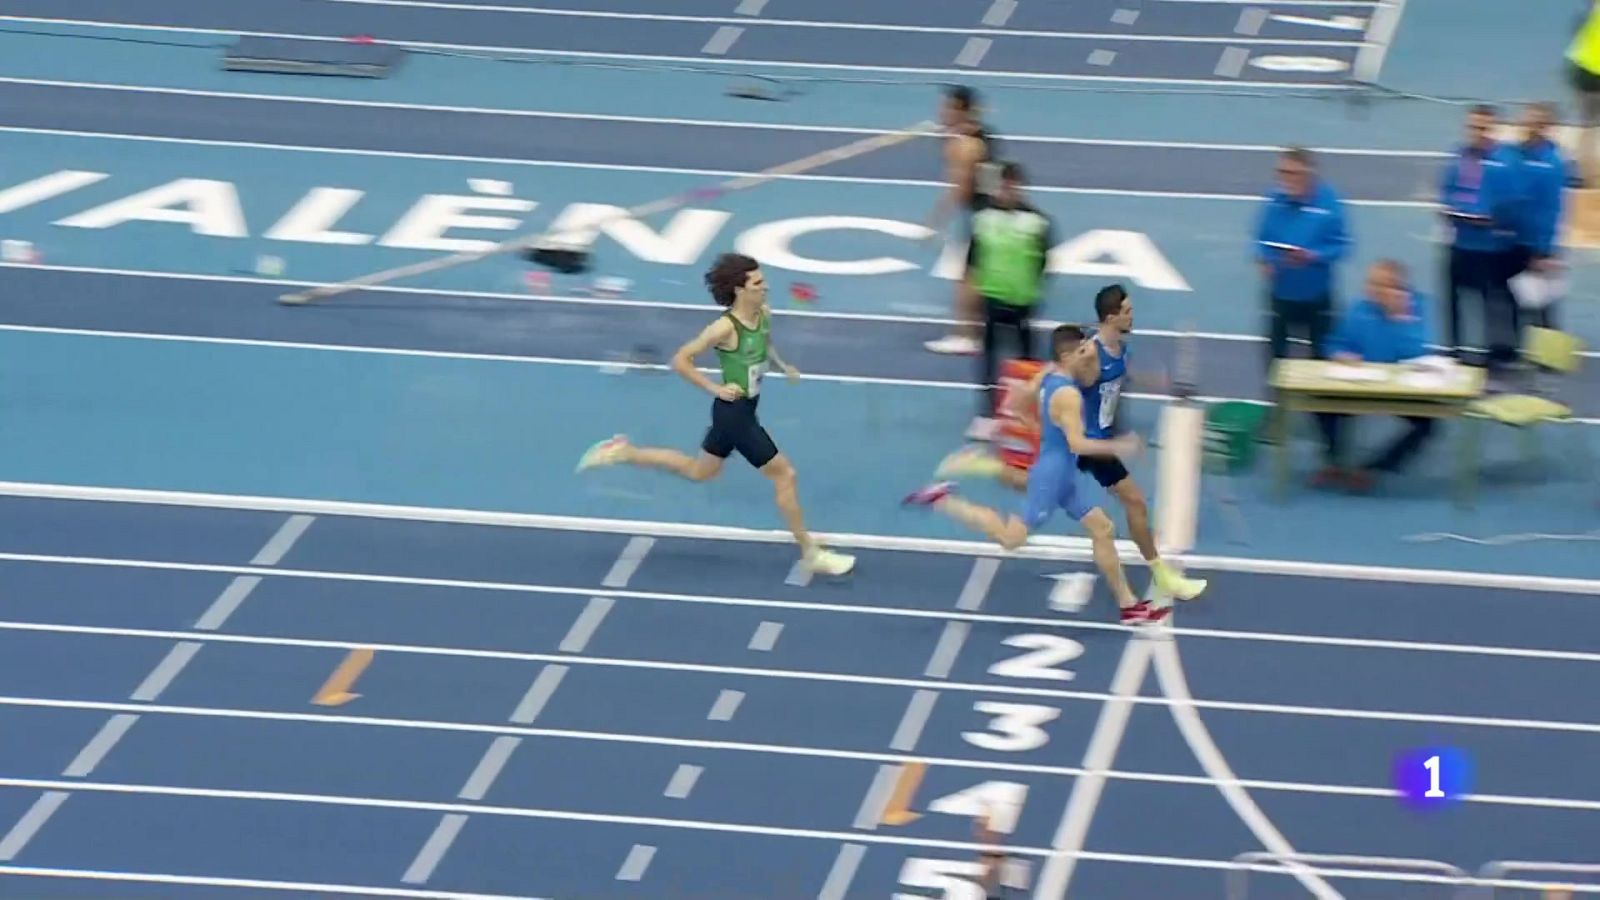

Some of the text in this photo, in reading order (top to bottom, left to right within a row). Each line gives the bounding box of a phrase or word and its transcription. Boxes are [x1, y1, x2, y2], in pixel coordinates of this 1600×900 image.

[1041, 571, 1097, 612] 1
[987, 633, 1085, 681] 2
[961, 701, 1062, 751] 3
[927, 780, 1030, 834] 4
[889, 857, 993, 900] 5
